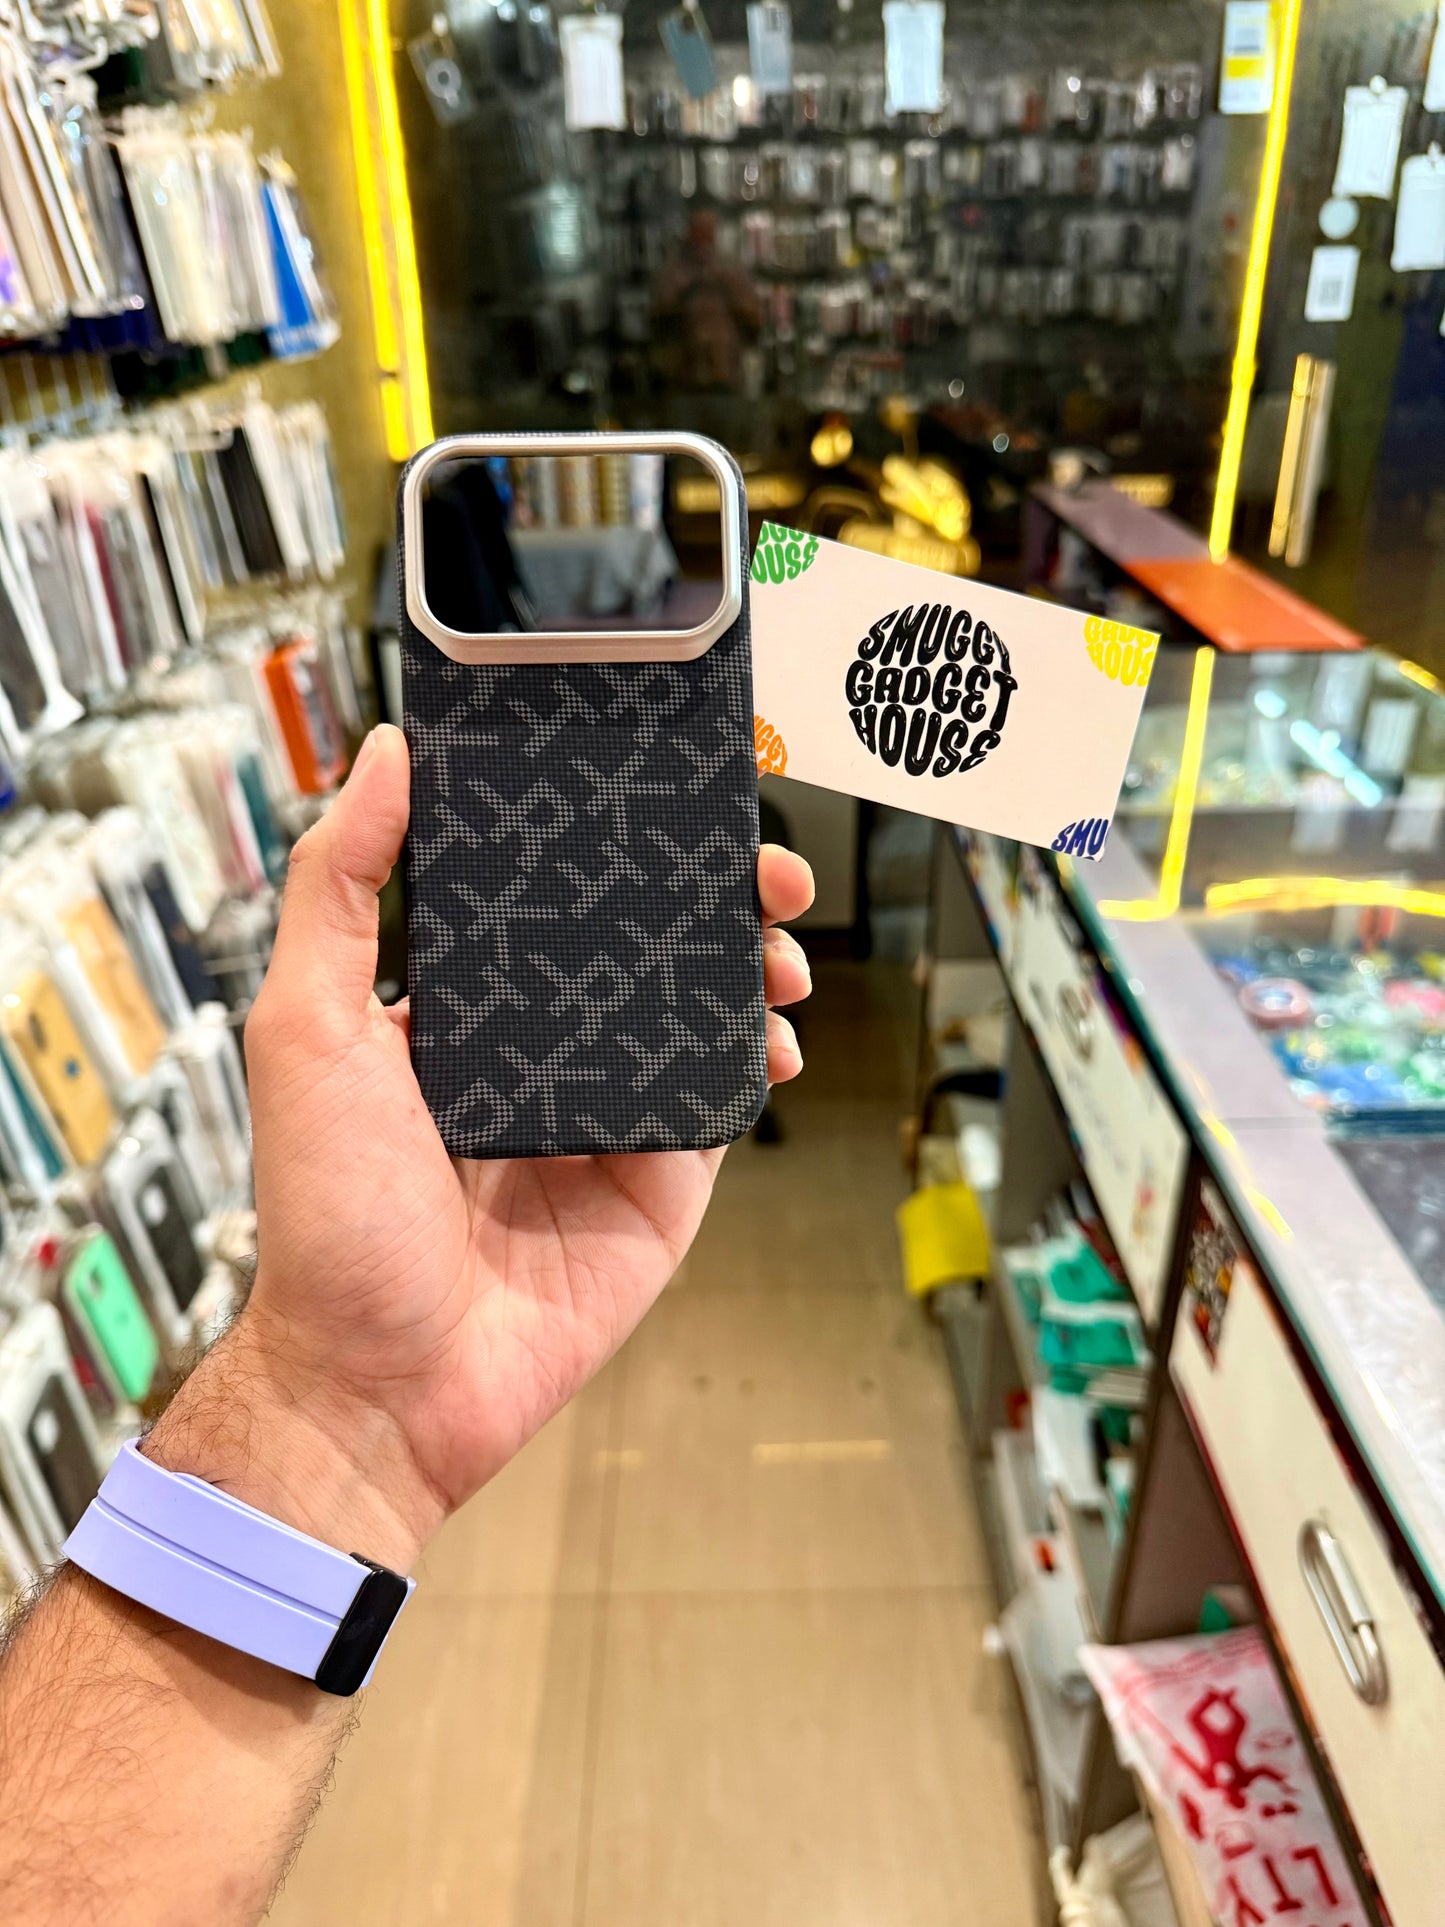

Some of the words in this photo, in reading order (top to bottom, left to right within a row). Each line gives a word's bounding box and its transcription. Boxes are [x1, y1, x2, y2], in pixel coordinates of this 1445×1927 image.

[751, 541, 820, 585] OUSE
[858, 603, 1011, 675] SMUGGY
[845, 660, 1018, 732] GADGET
[849, 703, 1001, 778] HOUSE
[1051, 818, 1109, 857] SMU
